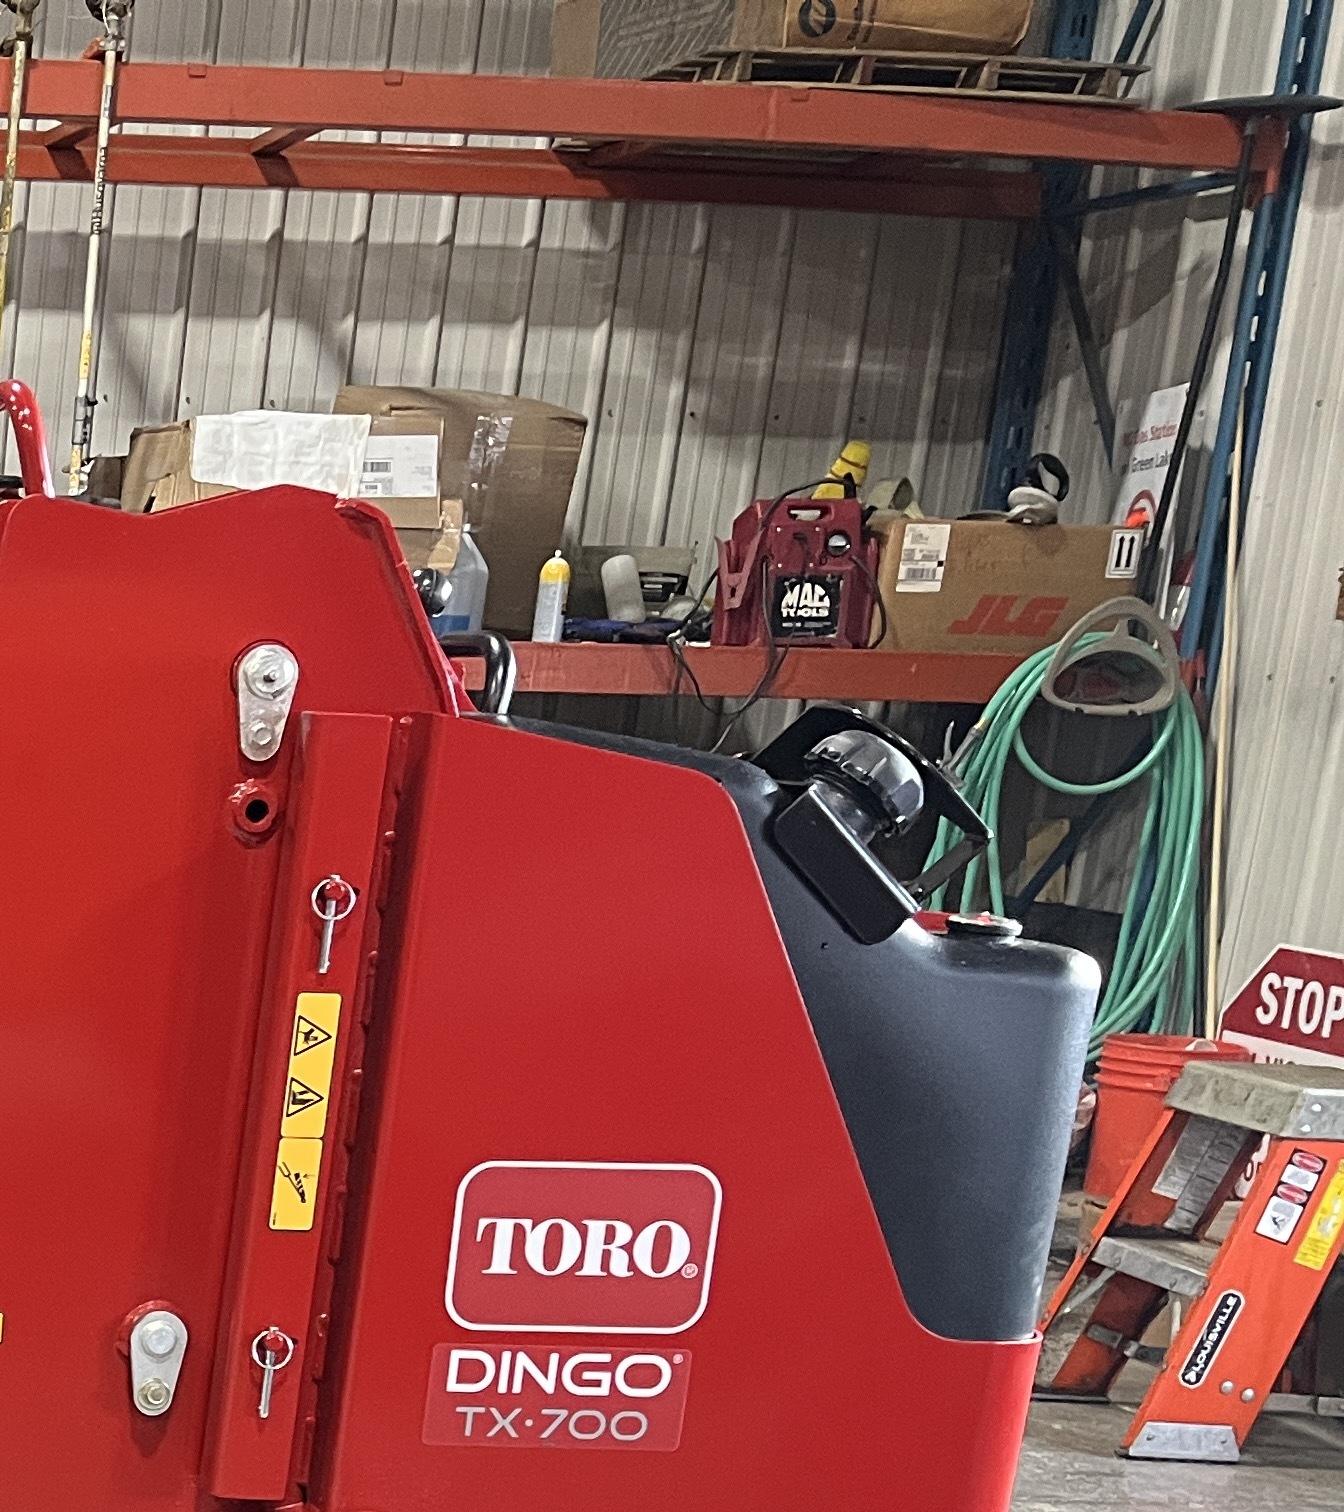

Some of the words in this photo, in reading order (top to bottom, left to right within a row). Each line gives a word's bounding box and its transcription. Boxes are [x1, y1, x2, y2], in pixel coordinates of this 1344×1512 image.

[780, 582, 831, 607] MAC
[946, 594, 1069, 637] JLG
[1255, 972, 1344, 1038] STOP
[1192, 1296, 1238, 1373] LOUISVILLE
[446, 1349, 673, 1399] DINGO
